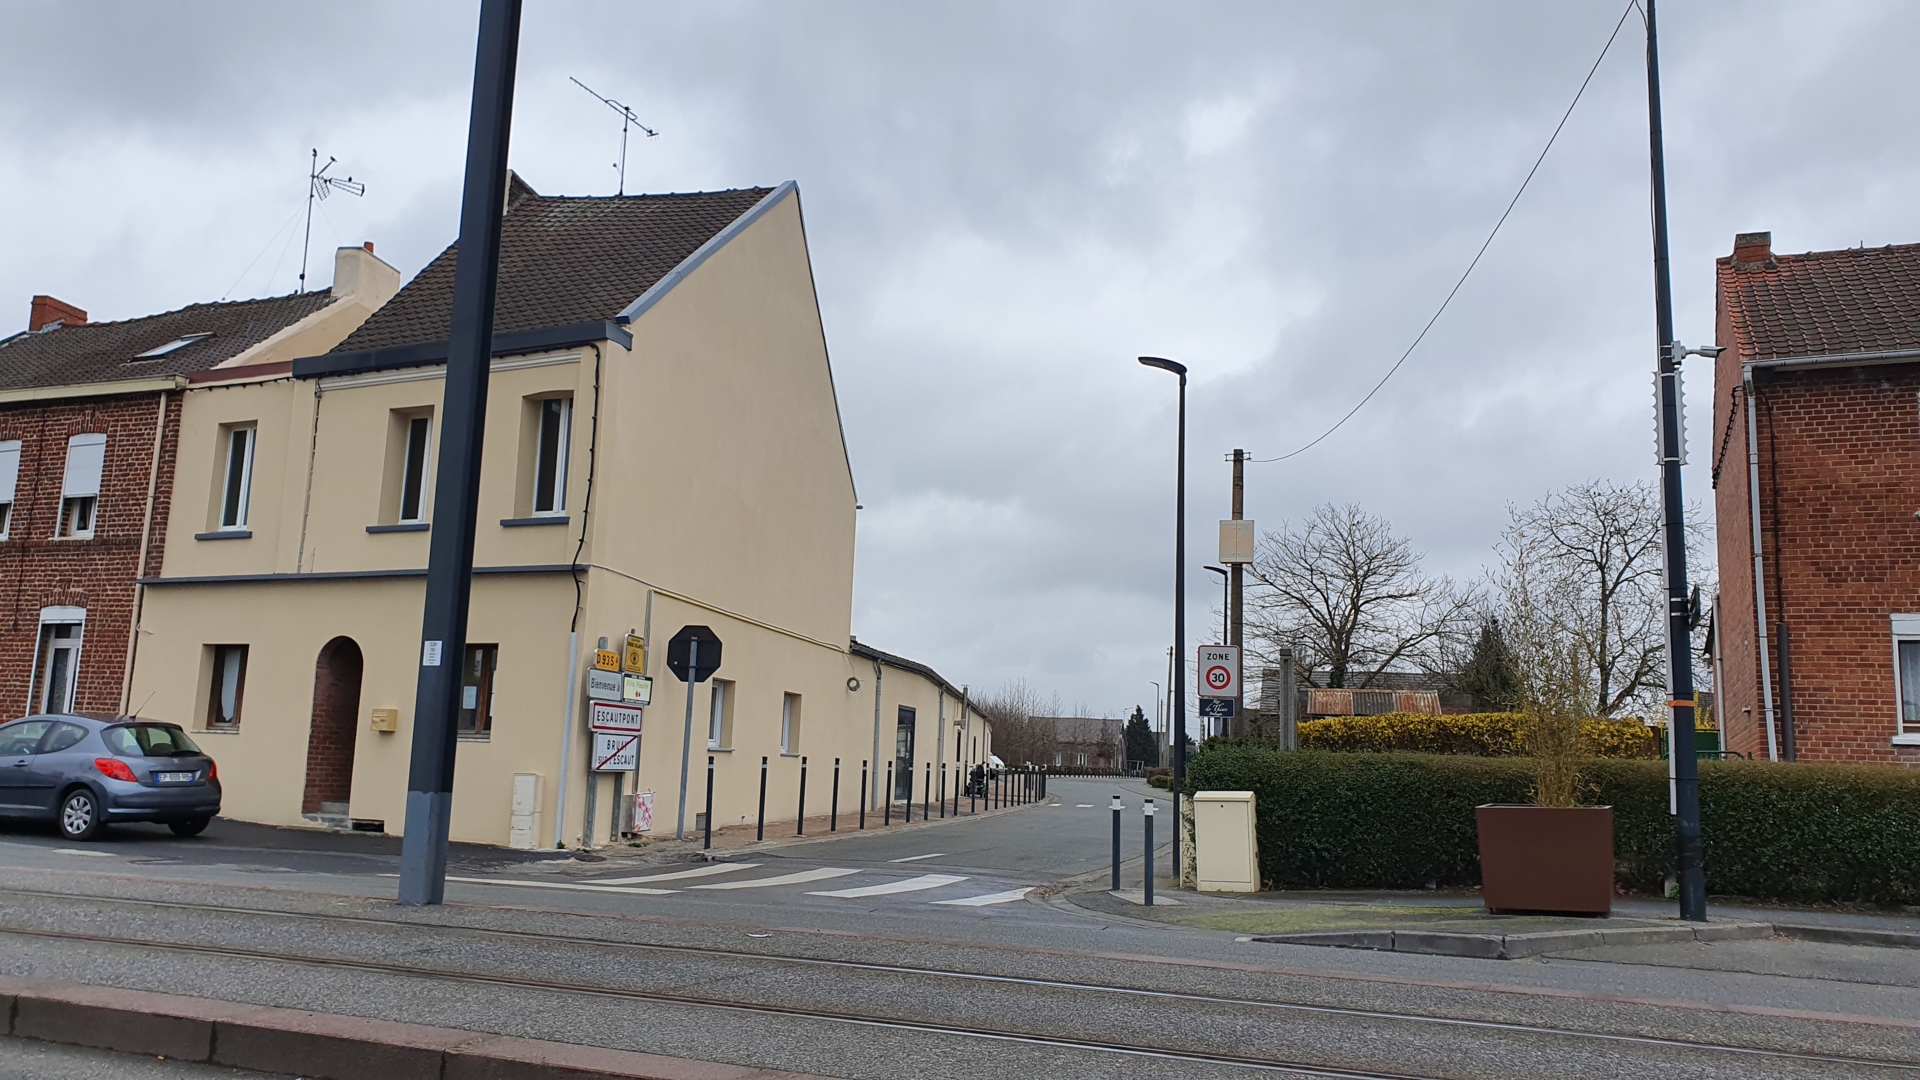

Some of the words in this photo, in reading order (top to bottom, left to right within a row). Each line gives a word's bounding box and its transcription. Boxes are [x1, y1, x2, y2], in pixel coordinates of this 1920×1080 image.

[596, 653, 601, 664] D
[602, 654, 614, 667] 935
[1206, 652, 1230, 661] ZONE
[591, 677, 616, 692] Bienvenue
[1211, 673, 1225, 683] 30
[596, 710, 639, 725] ESCAUTPONT
